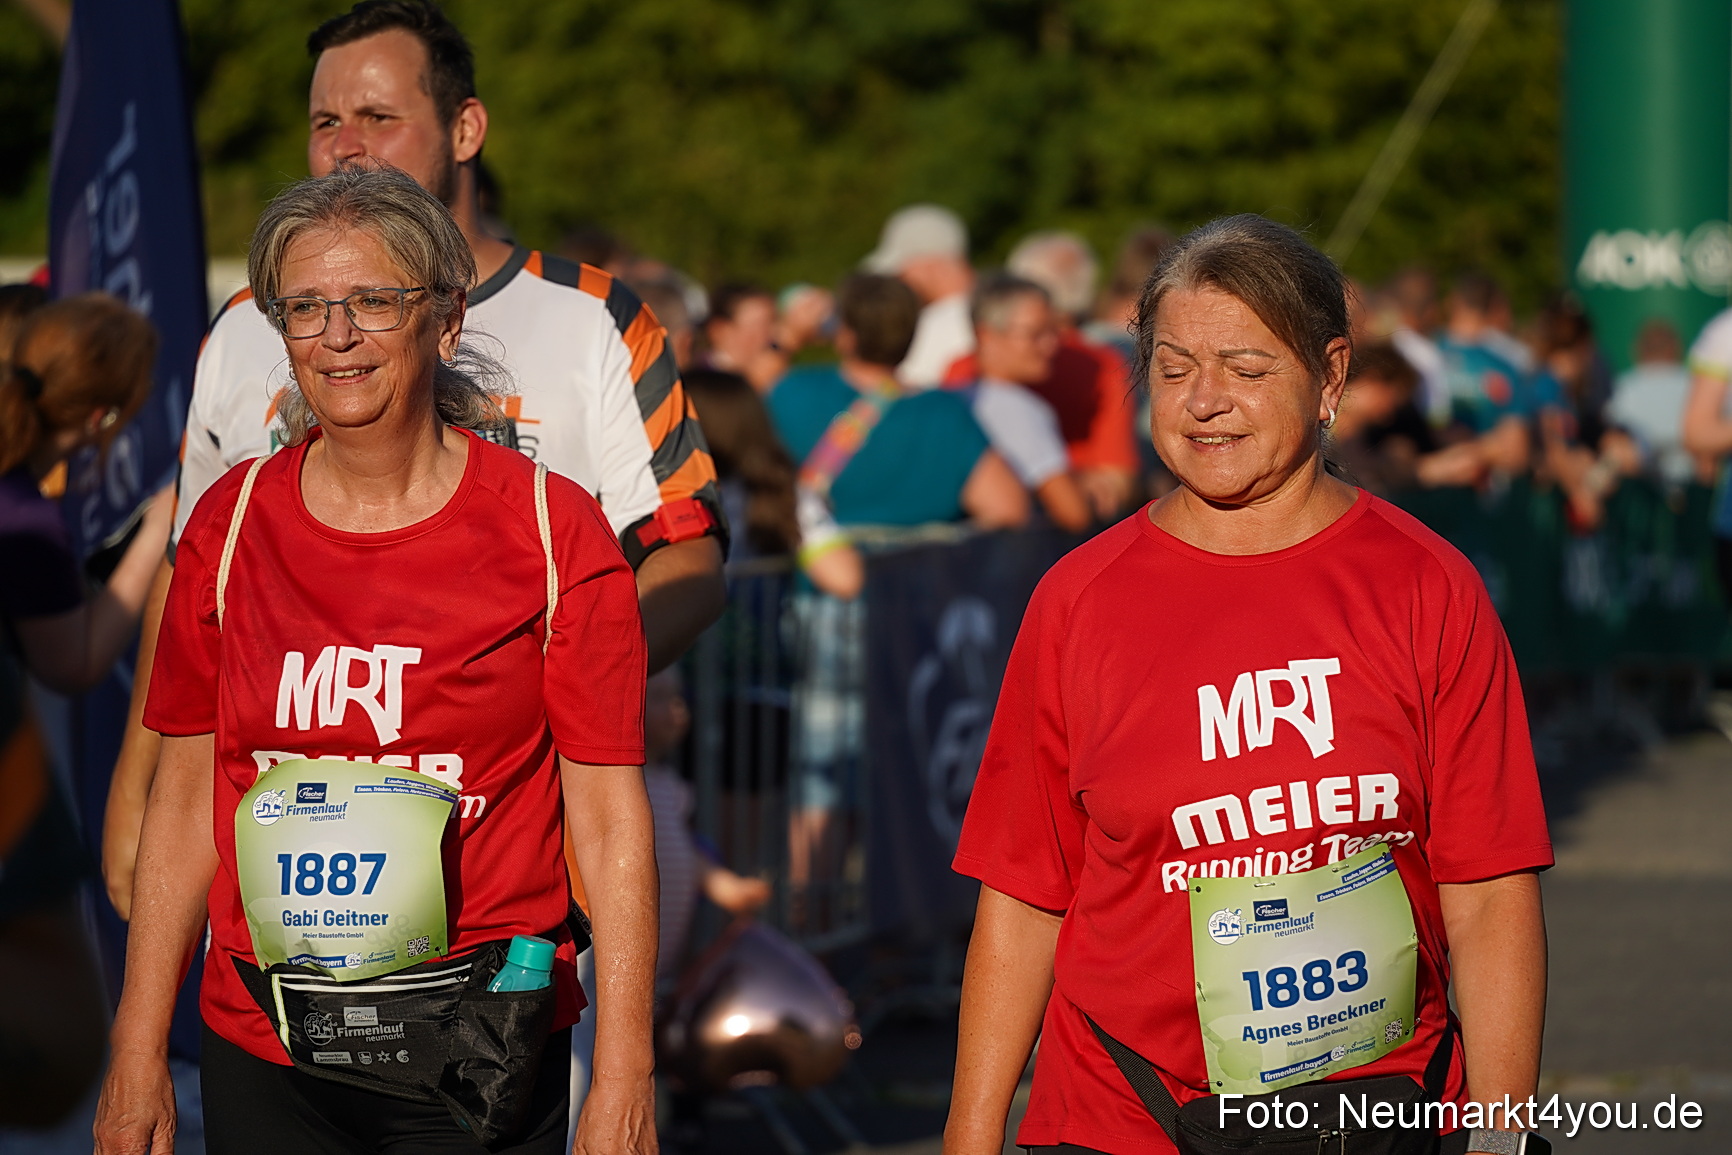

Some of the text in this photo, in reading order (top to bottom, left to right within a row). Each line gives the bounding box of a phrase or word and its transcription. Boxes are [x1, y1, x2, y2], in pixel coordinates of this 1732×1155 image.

[276, 644, 422, 746] MRT
[1197, 657, 1341, 762] MRT
[286, 802, 348, 816] Firmenlauf
[309, 812, 346, 823] neumarkt
[1171, 773, 1399, 849] MEIER
[1161, 830, 1414, 893] Running Team
[277, 853, 387, 896] 1887
[282, 909, 389, 927] Gabi Geitner
[1246, 912, 1315, 935] Firmenlauf
[1274, 923, 1315, 938] neumarkt
[1242, 950, 1369, 1011] 1883
[337, 1022, 404, 1038] Firmenlauf
[1242, 998, 1386, 1045] Agnes Breckner
[366, 1032, 406, 1043] neumarkt
[1287, 1025, 1349, 1047] Meier Baustoffe GmbH
[1264, 1056, 1329, 1081] firmenlauf.bayern
